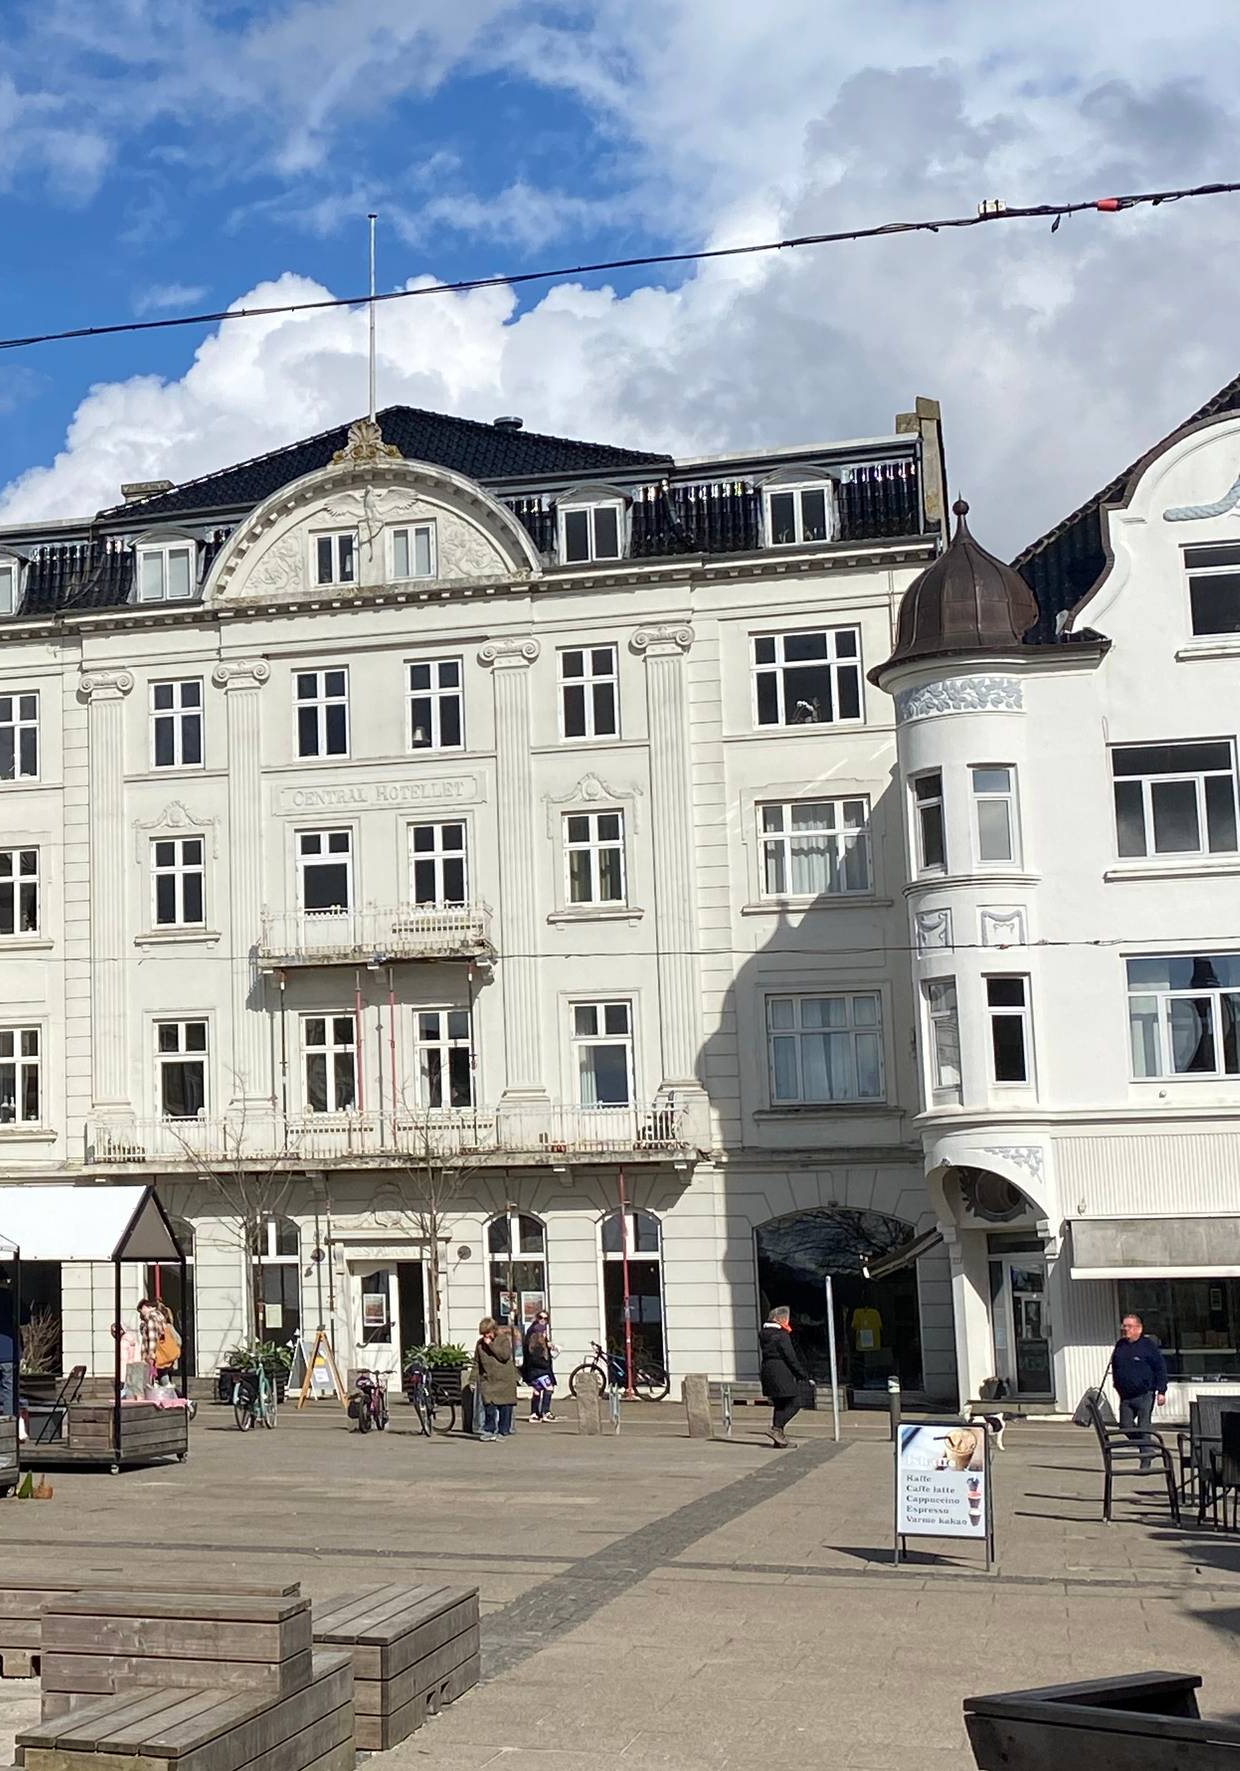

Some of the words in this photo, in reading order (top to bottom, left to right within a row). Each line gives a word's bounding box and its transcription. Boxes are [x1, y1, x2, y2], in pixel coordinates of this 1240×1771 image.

[293, 788, 369, 806] CENTRAL
[375, 781, 464, 801] HOTELLET
[906, 1474, 932, 1482] Kaffe
[933, 1485, 956, 1494] latte
[906, 1495, 960, 1505] Cappuccino
[906, 1505, 950, 1515] Espresso
[906, 1515, 937, 1524] Varme
[938, 1517, 968, 1526] kakao
